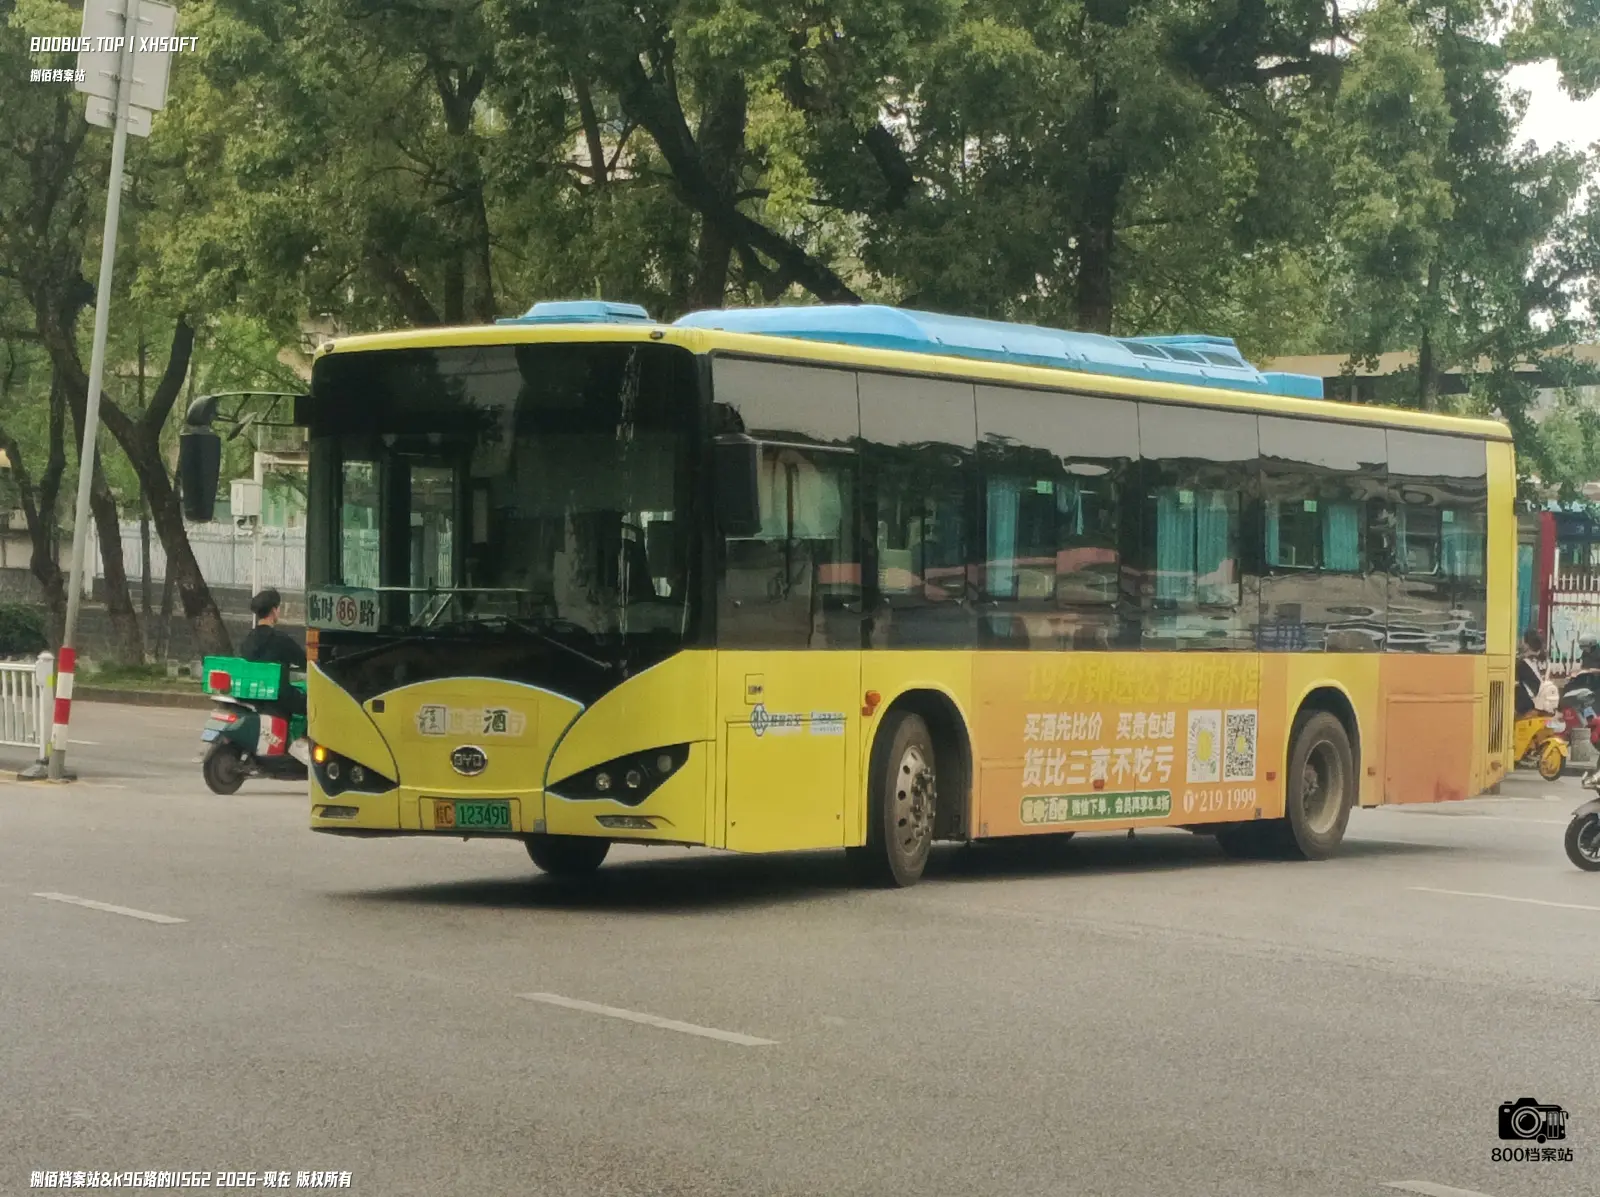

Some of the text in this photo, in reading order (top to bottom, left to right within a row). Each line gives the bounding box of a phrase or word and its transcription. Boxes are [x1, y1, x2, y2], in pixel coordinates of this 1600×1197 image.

[1023, 711, 1175, 741] 买酒先比价 买贵包退
[454, 754, 482, 766] BYD
[1022, 746, 1174, 787] 货比三家不吃亏
[1199, 788, 1256, 812] 219 1999
